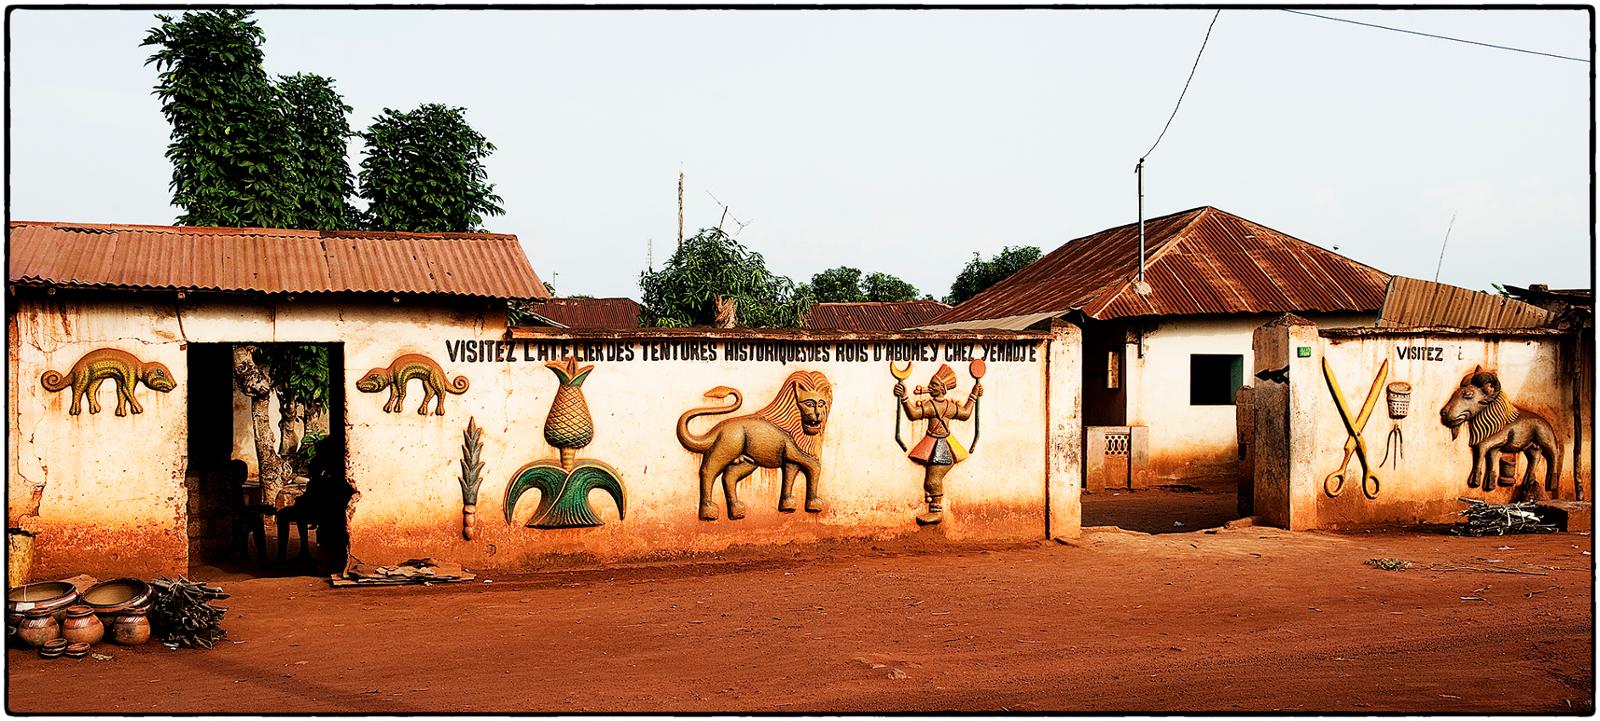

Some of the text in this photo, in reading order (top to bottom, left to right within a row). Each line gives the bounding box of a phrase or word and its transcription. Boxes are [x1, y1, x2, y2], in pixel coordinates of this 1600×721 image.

[445, 339, 517, 362] VISITEZ
[606, 341, 635, 361] DES
[640, 341, 717, 361] TENTURES
[724, 341, 806, 365] HISTORIQUES
[807, 341, 831, 362] DES
[835, 341, 868, 362] ROIS
[944, 341, 974, 362] CHEZ
[1396, 346, 1443, 362] VISITEZ
